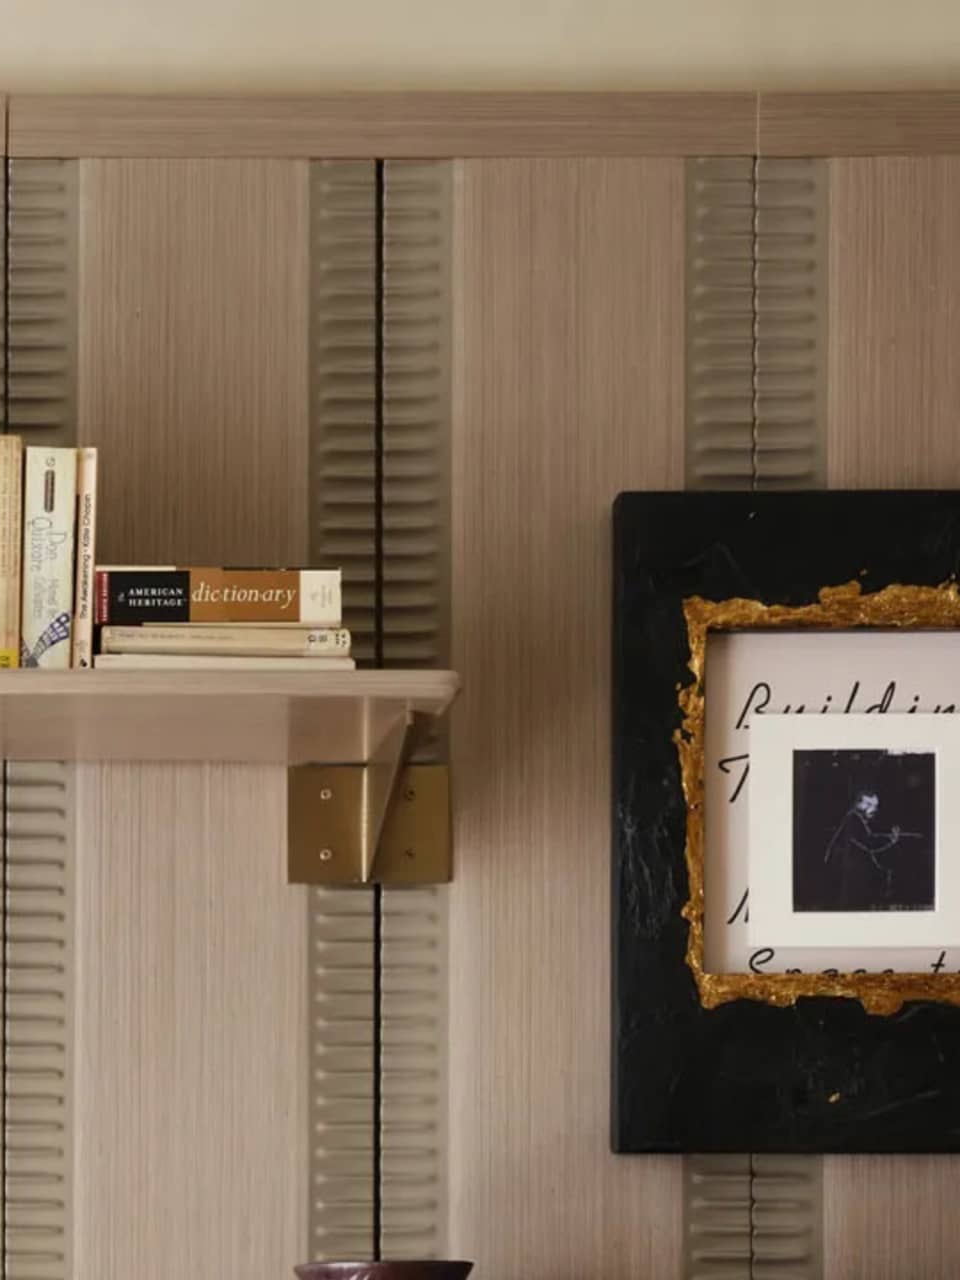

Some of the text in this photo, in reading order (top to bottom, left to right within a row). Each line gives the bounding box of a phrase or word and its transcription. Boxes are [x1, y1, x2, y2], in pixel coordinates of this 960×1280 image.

[82, 494, 91, 526] Chopin
[45, 531, 68, 560] Don
[81, 554, 91, 601] Awakening
[128, 588, 184, 596] AMERICAN
[128, 598, 183, 606] HERITAGE
